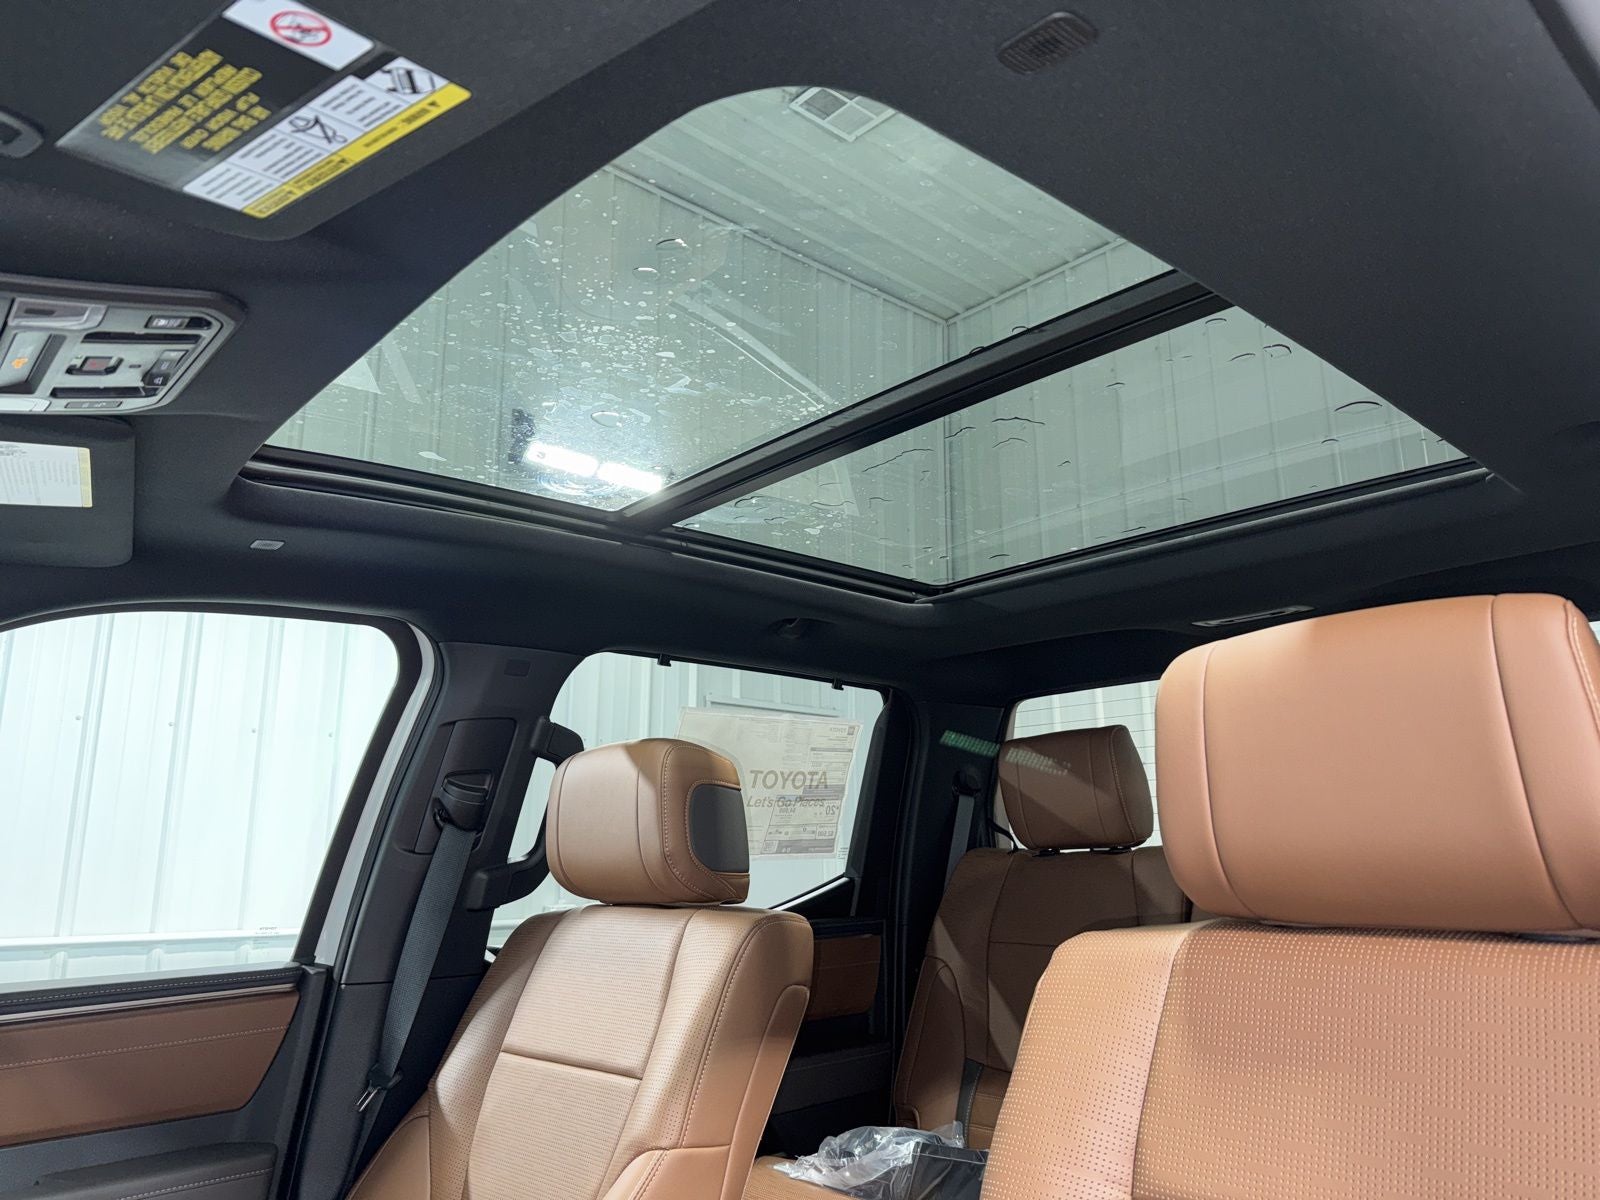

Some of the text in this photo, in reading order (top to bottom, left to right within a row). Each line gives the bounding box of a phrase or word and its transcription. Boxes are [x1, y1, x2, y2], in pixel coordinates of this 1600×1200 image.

[750, 769, 829, 790] TOYOTA
[746, 796, 773, 808] Let's
[776, 796, 792, 808] Go
